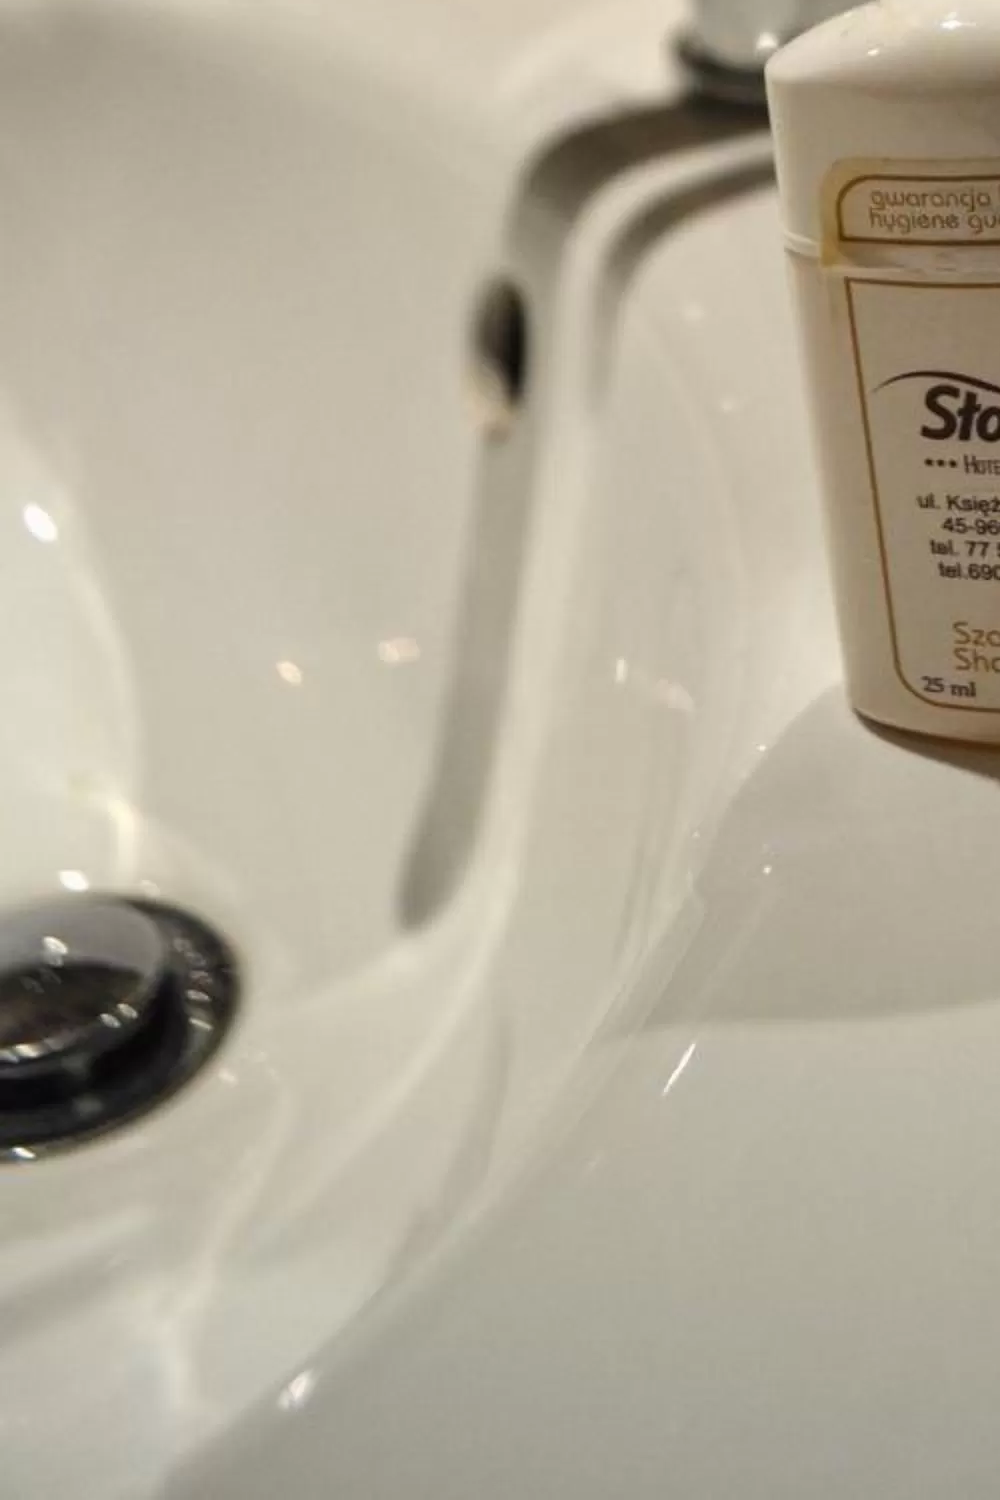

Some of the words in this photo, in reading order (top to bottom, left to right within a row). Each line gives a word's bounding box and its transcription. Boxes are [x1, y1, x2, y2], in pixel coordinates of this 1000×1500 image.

[868, 206, 960, 234] hygiene
[965, 541, 991, 558] 77
[950, 681, 977, 698] ml
